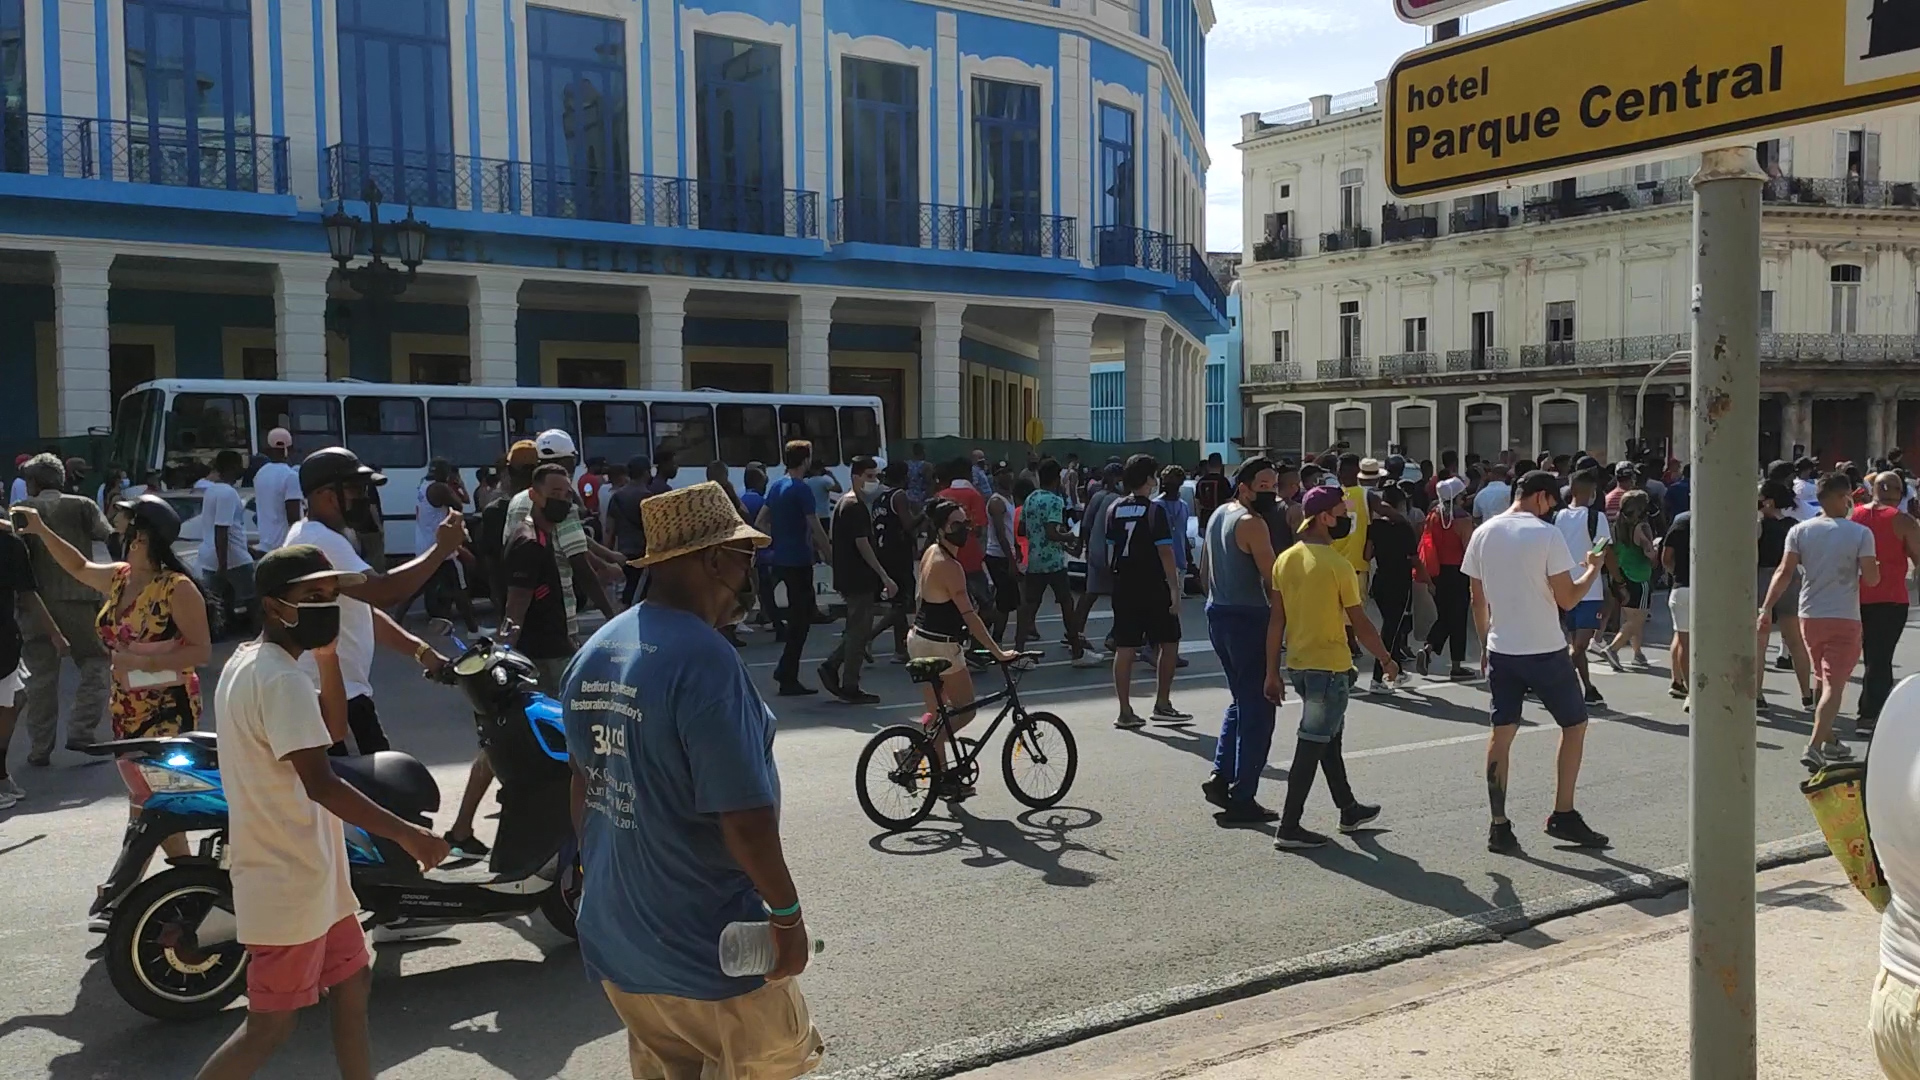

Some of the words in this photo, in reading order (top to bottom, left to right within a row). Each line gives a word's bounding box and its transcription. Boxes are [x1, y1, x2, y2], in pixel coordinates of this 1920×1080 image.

[1406, 106, 1560, 164] Parque
[1579, 45, 1783, 128] Central
[1407, 66, 1489, 112] hotel
[1121, 520, 1137, 557] 7
